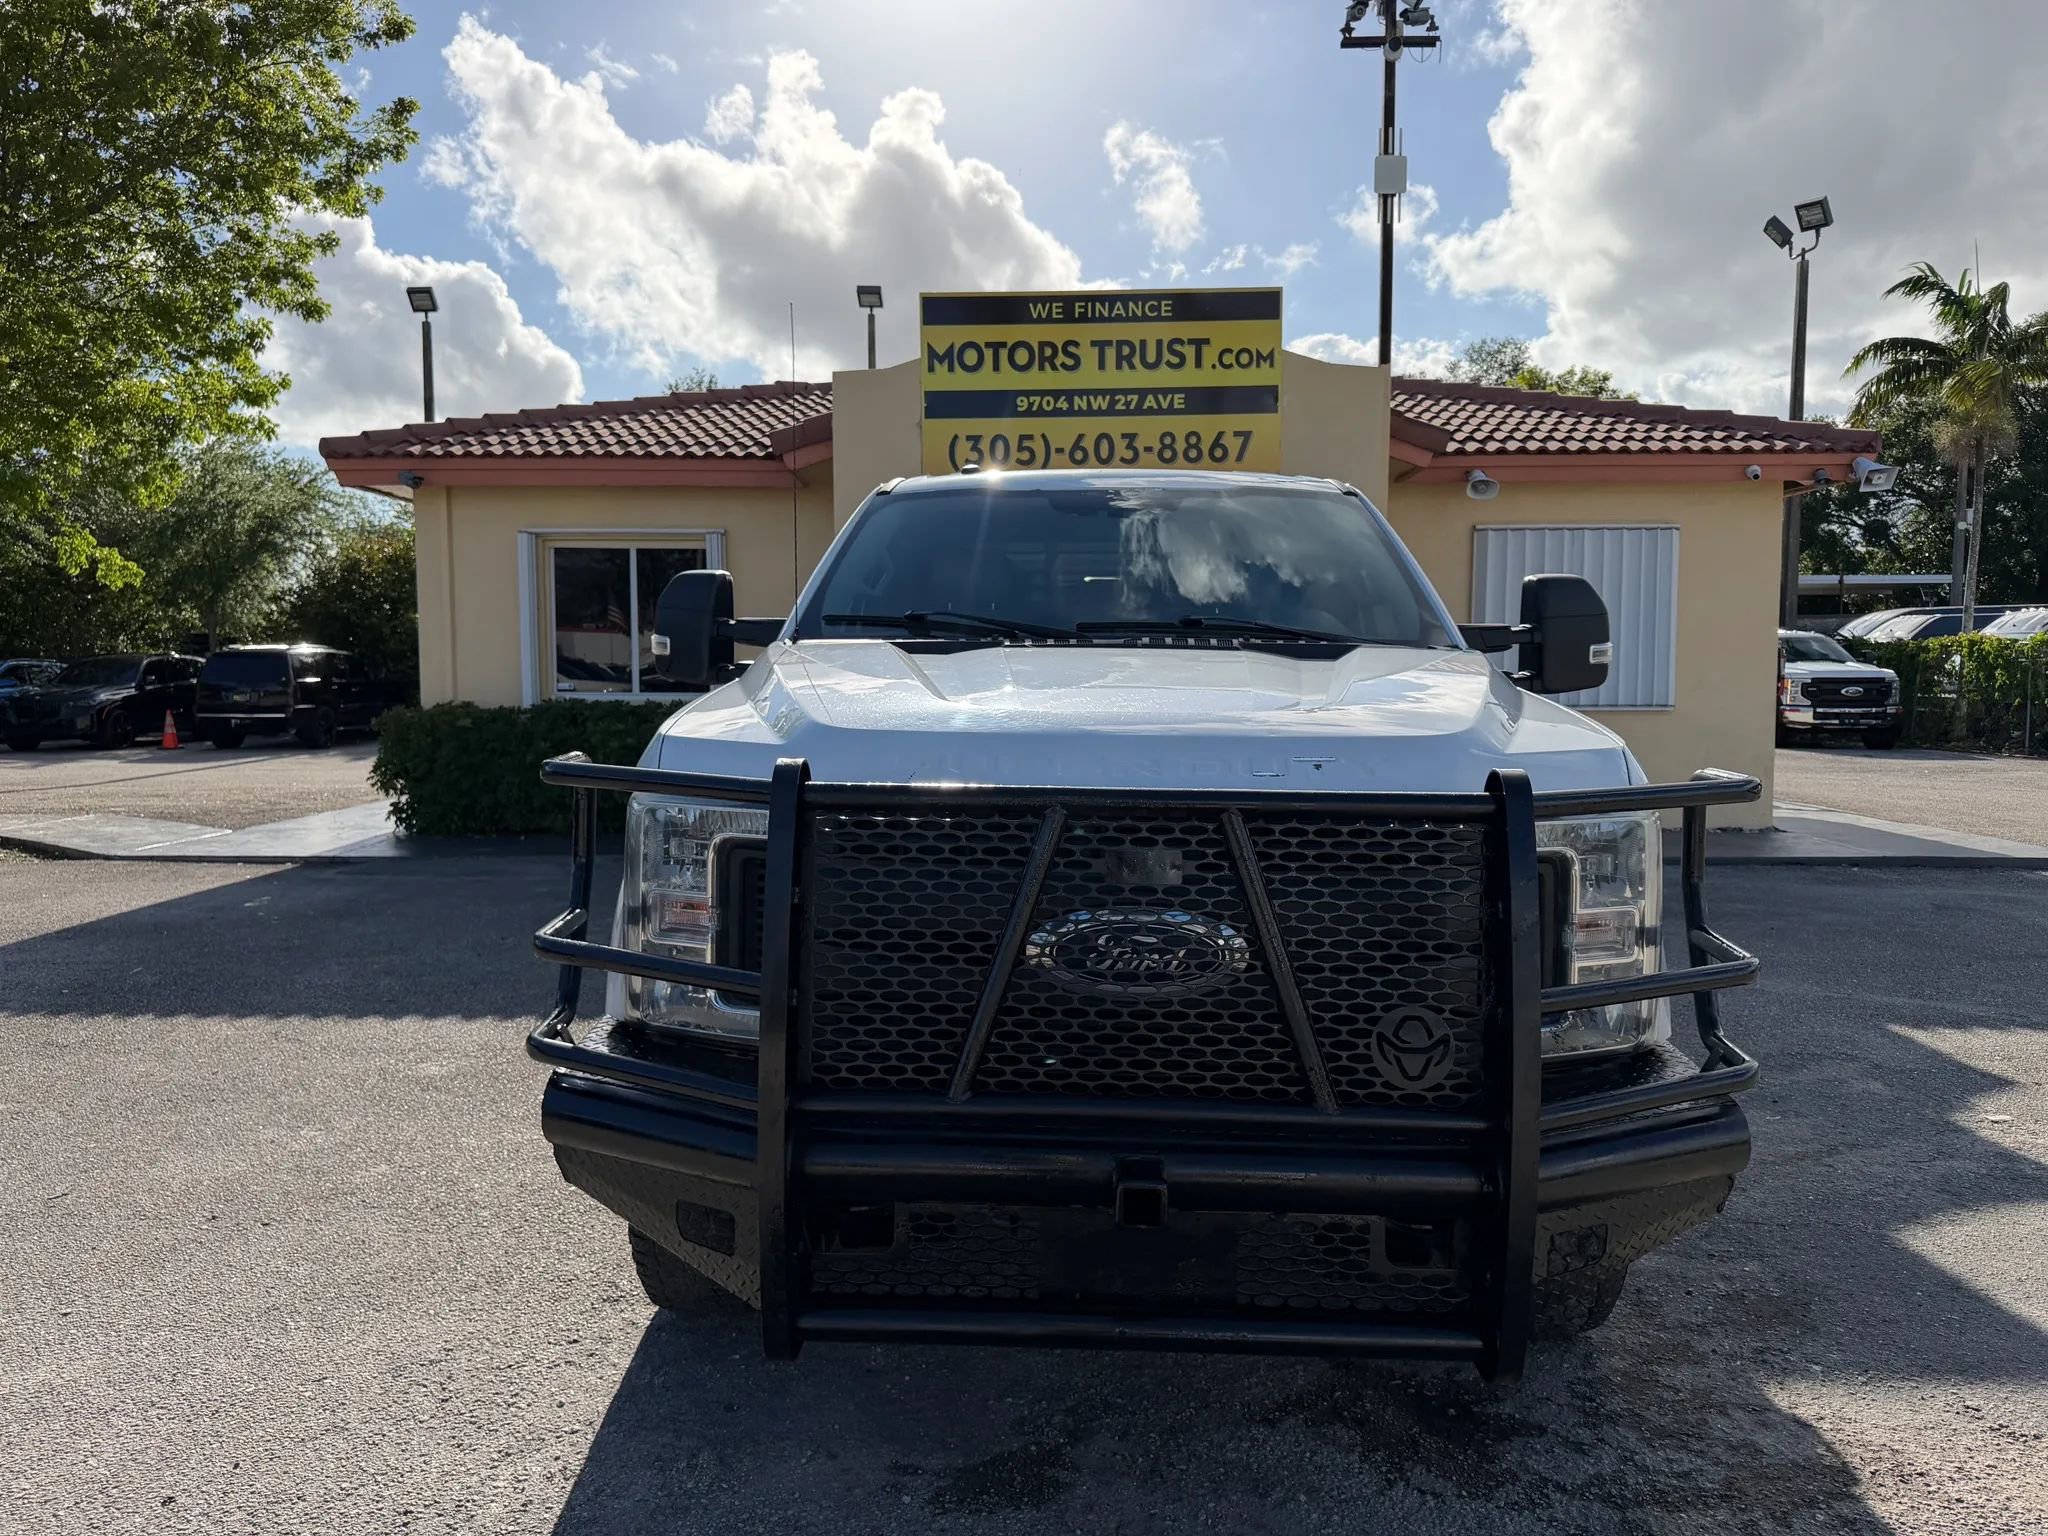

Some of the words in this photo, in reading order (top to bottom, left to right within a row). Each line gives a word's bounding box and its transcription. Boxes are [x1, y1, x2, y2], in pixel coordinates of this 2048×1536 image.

[1029, 303, 1064, 319] WE
[1074, 300, 1173, 318] FINANCE
[926, 340, 1082, 374] MOTORS
[1016, 396, 1069, 412] 9704
[1073, 395, 1109, 411] NW
[1114, 395, 1139, 410] 27
[1142, 394, 1186, 410] AVE
[949, 430, 1254, 472] (305)-603-8867
